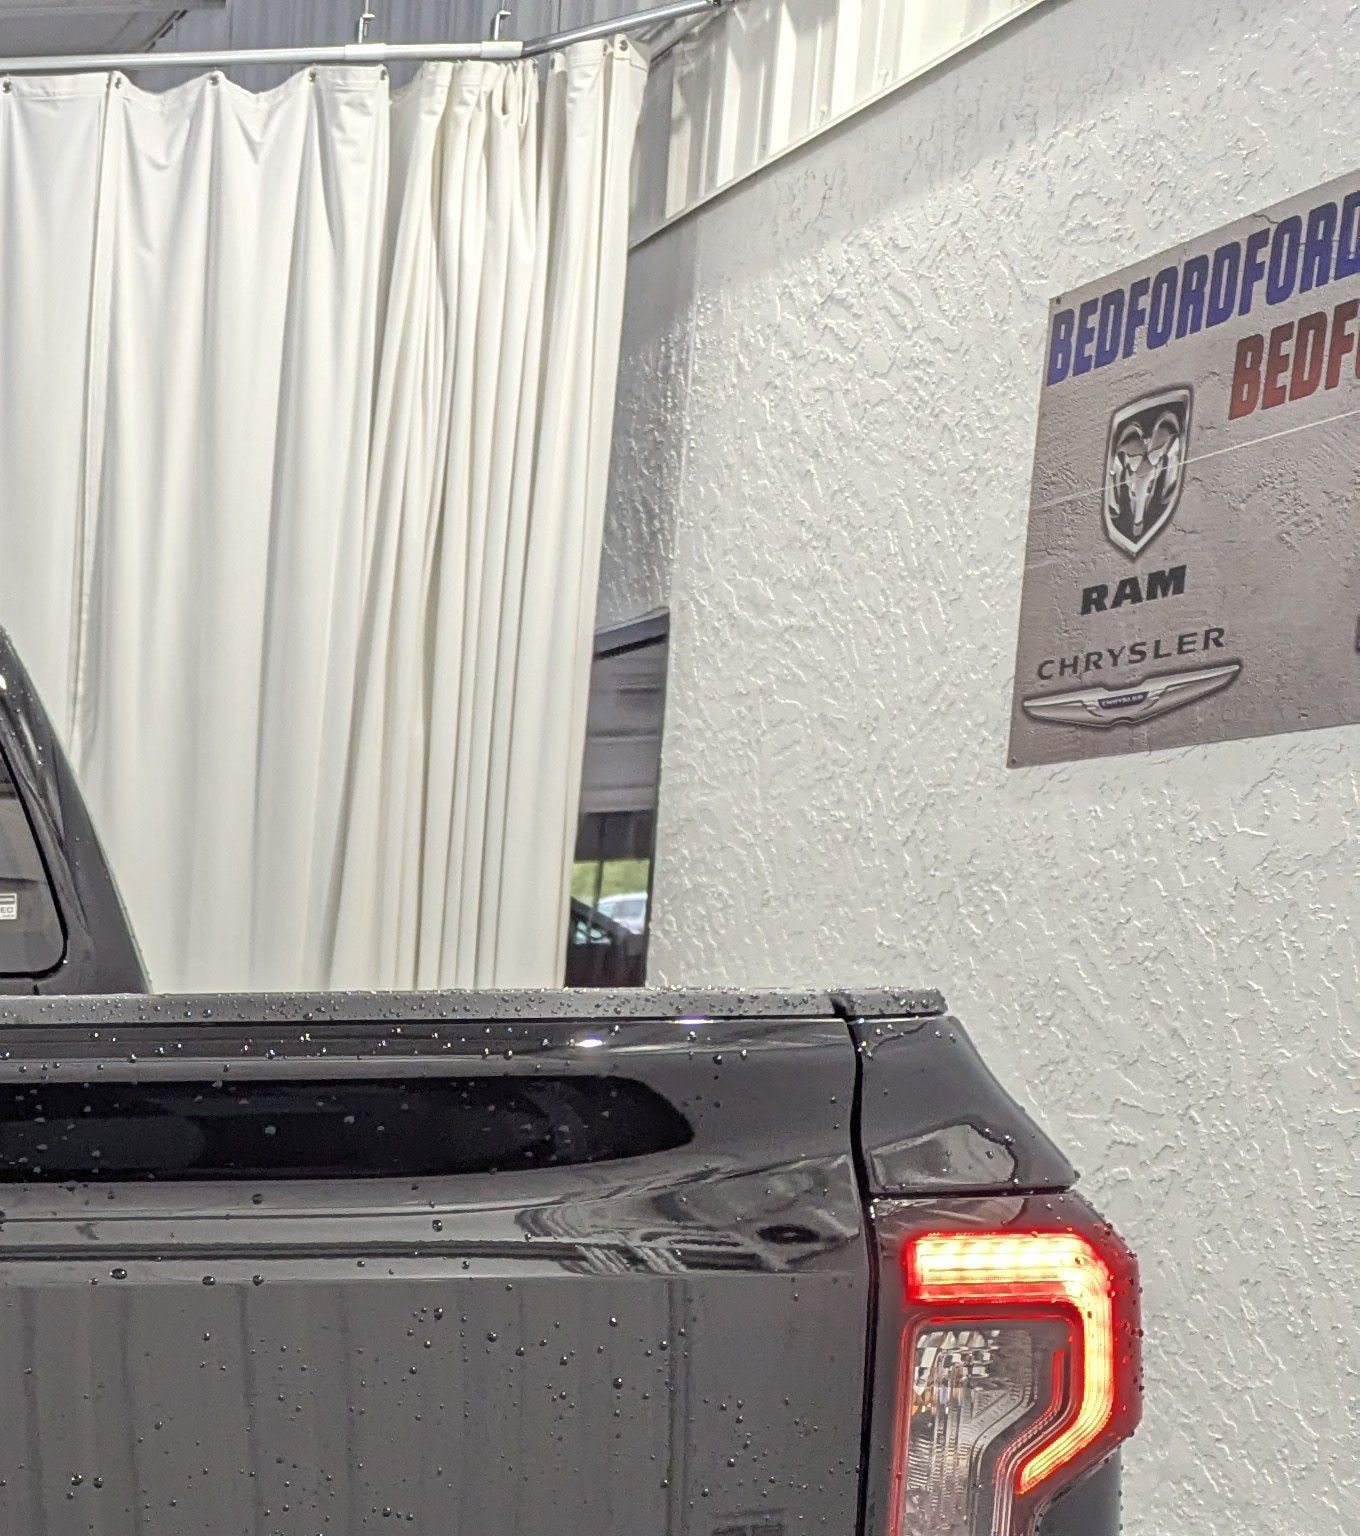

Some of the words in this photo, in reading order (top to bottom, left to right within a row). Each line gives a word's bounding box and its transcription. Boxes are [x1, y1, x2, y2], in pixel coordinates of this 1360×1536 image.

[1046, 190, 1360, 386] BEDFORDFORD
[1228, 298, 1360, 420] BEDF
[1080, 565, 1187, 616] RAM
[1037, 627, 1225, 680] CHRYSLER
